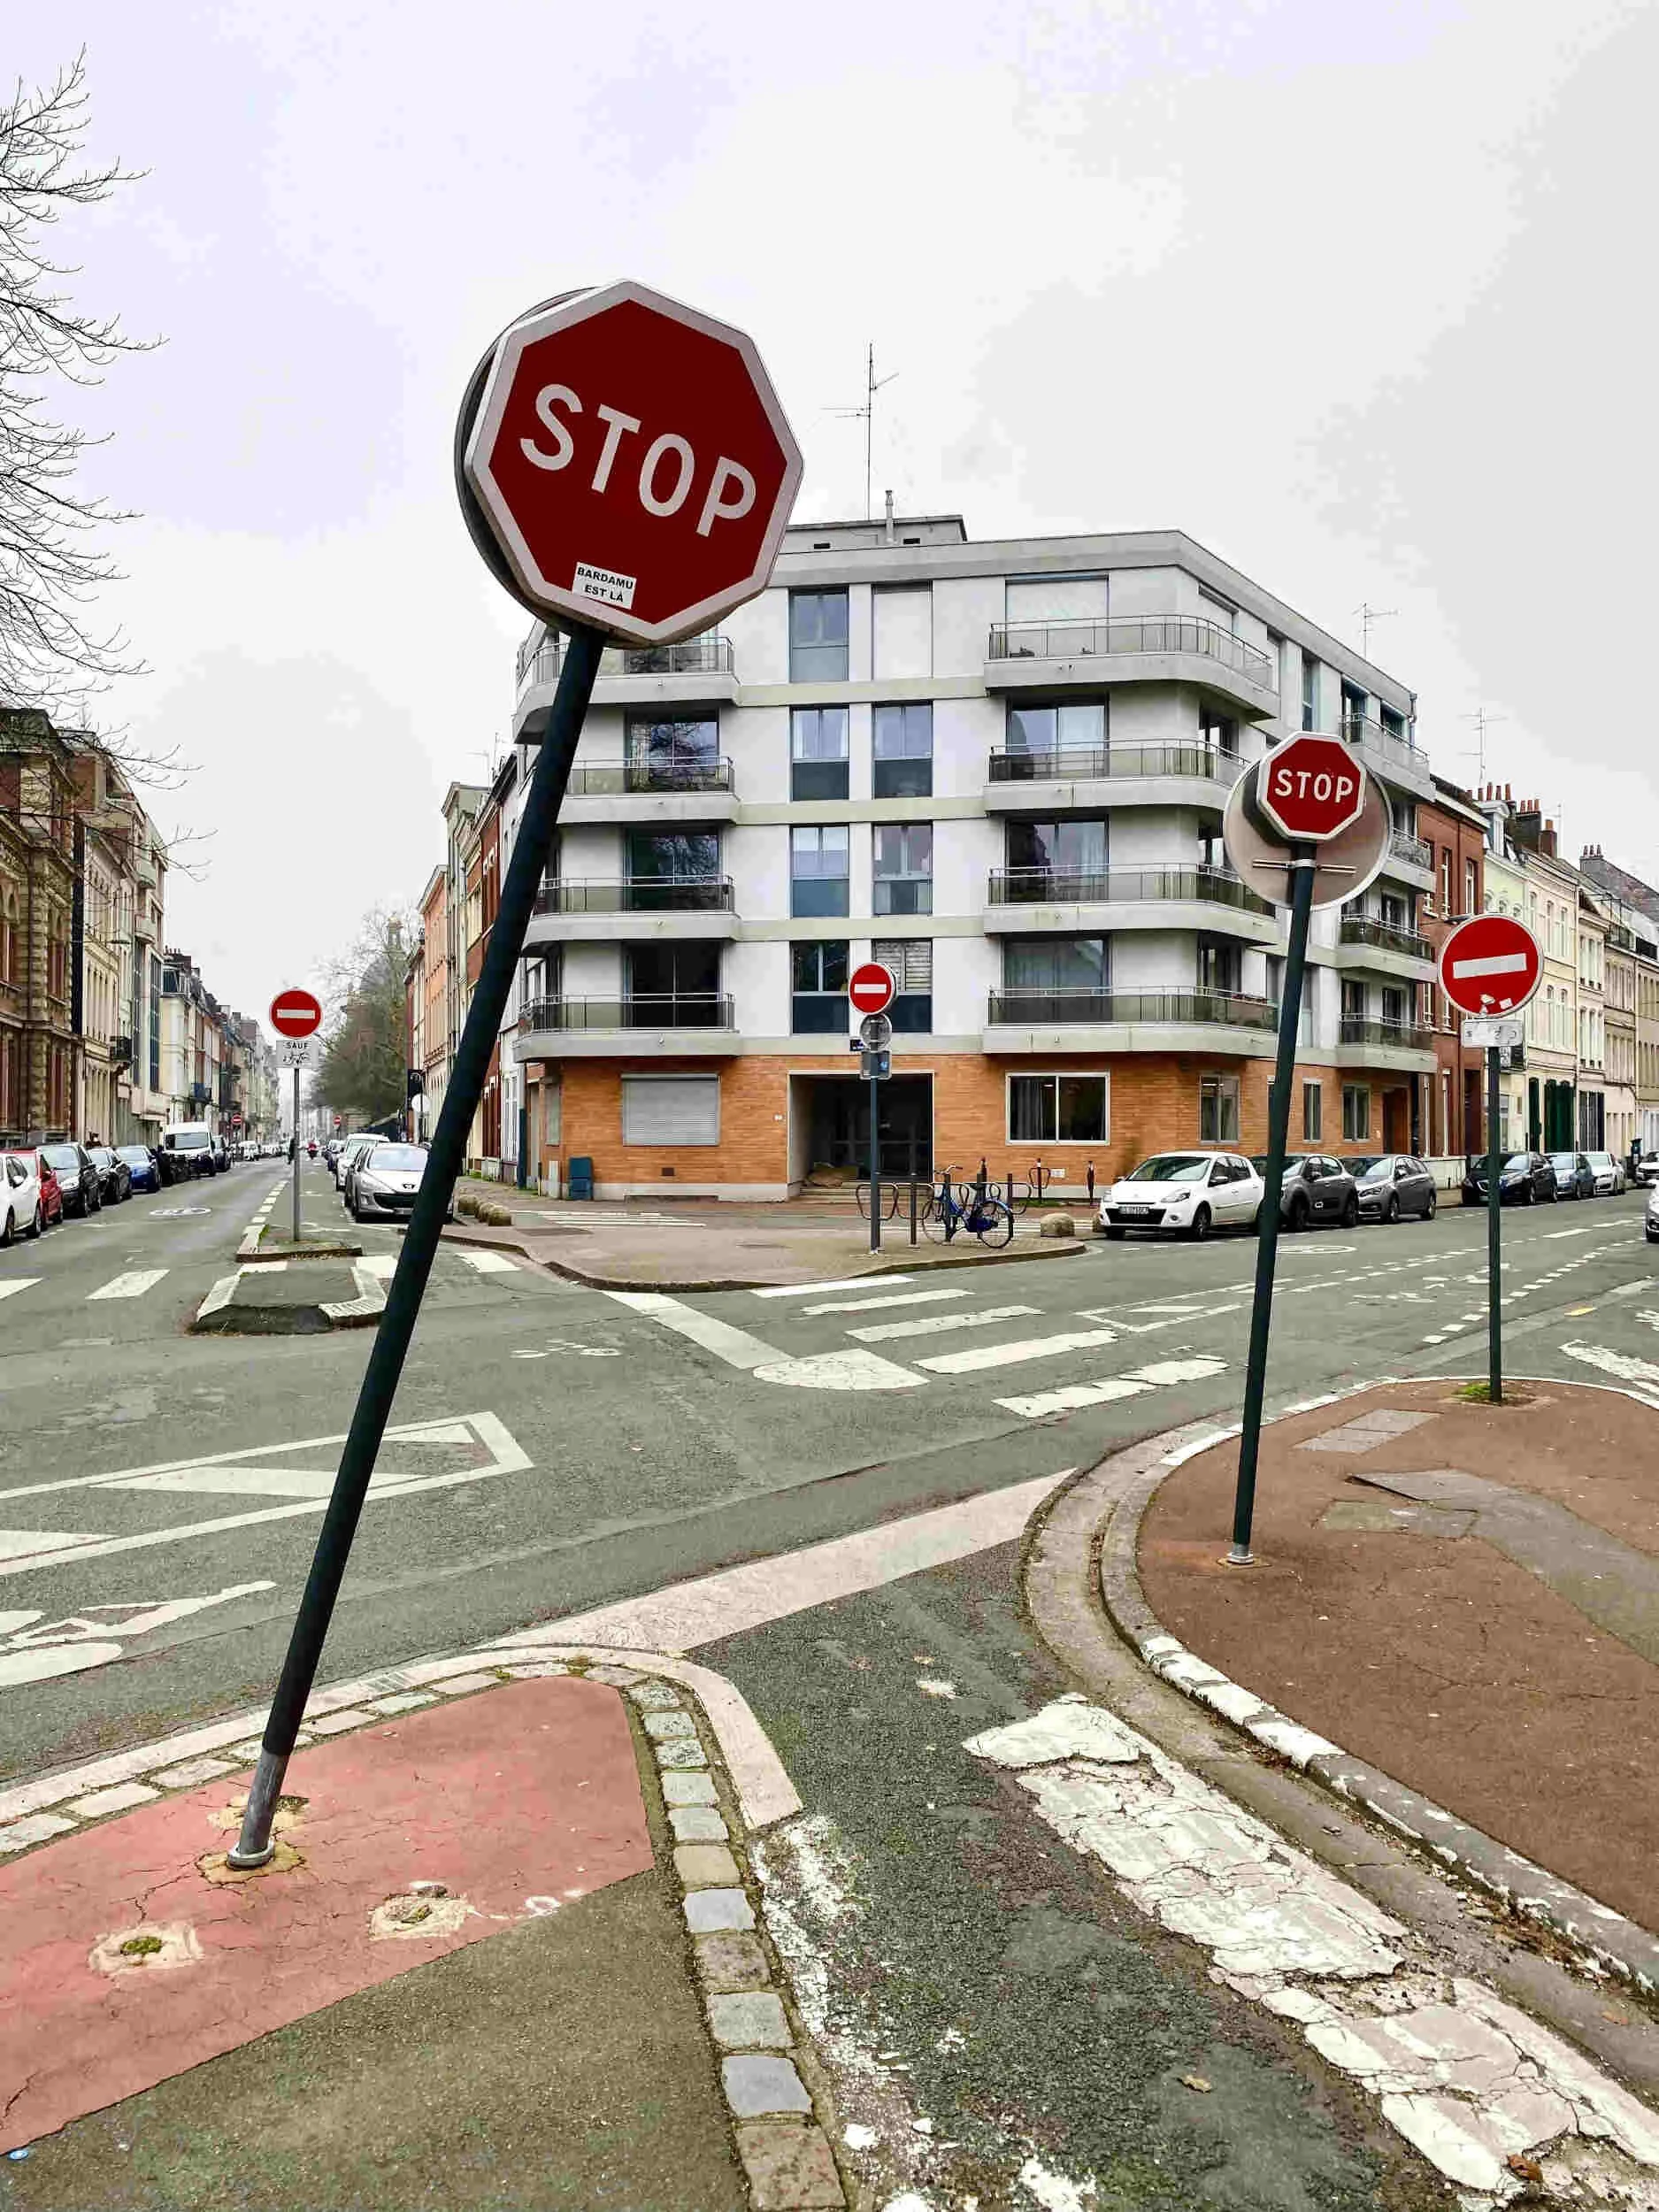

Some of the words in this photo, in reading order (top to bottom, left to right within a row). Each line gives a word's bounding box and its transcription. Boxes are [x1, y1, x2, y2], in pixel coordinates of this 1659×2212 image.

[519, 383, 757, 537] STOP
[577, 566, 634, 589] BARDAMU
[584, 584, 607, 597] EST
[1274, 768, 1354, 803] STOP
